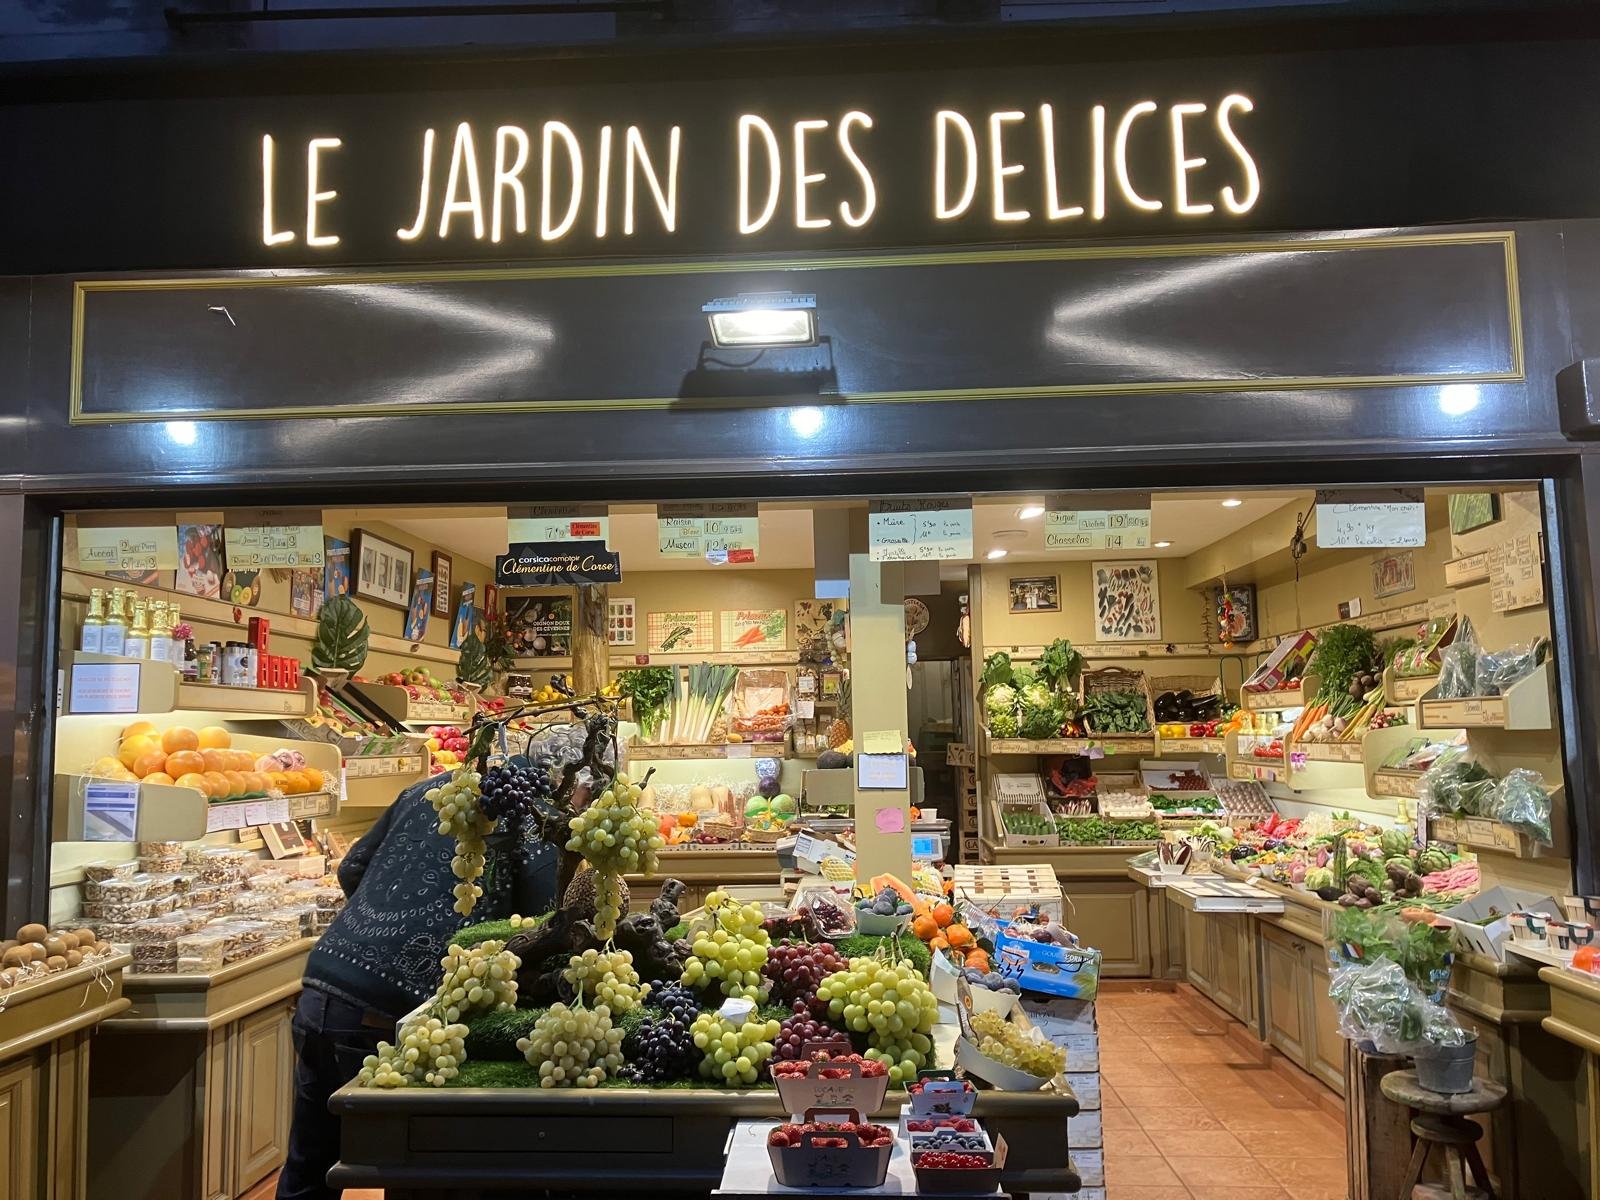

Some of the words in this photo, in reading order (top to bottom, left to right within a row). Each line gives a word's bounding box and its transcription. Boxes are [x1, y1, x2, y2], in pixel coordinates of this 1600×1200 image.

[262, 133, 342, 248] LE
[396, 120, 681, 244] JARDIN
[737, 111, 877, 235] DES
[935, 93, 1262, 222] DELICES
[1046, 533, 1090, 546] Chasselas
[502, 558, 564, 576] Clémentine
[566, 559, 580, 573] de
[581, 555, 615, 573] Corse
